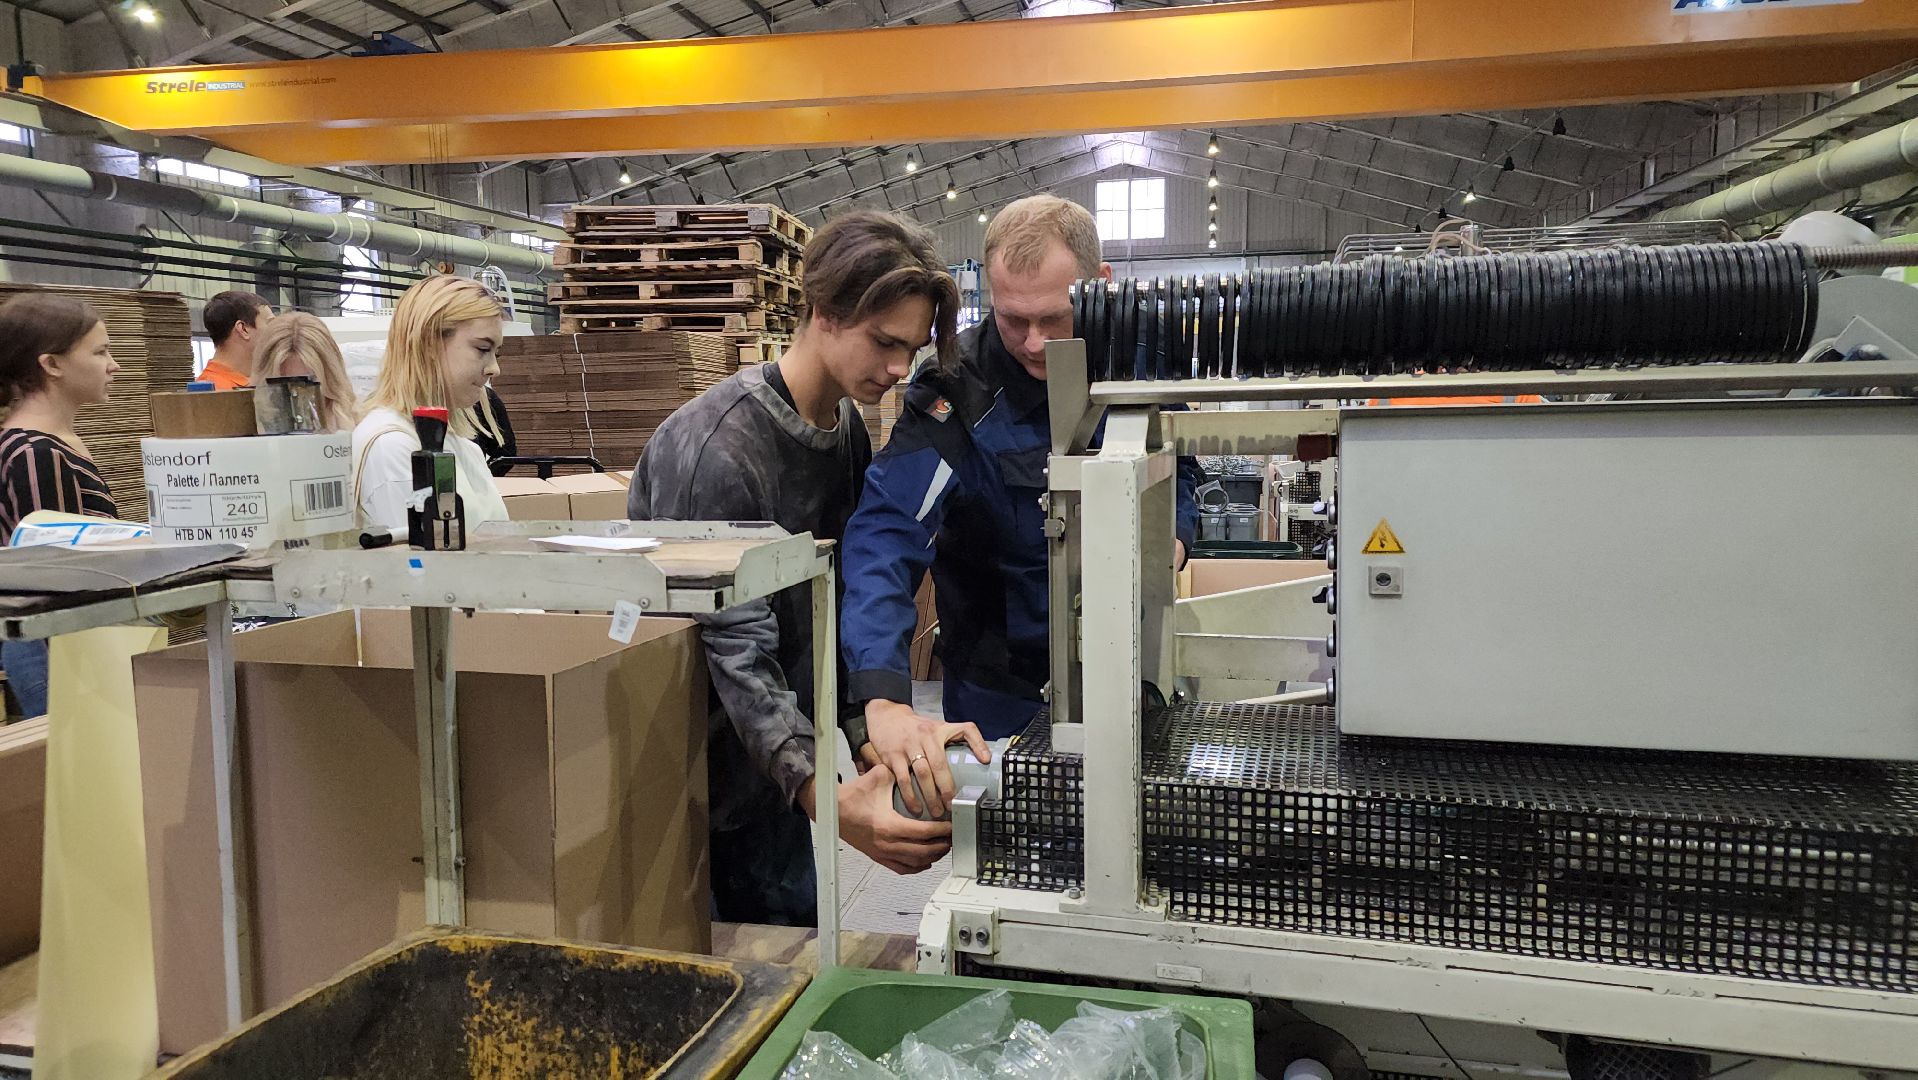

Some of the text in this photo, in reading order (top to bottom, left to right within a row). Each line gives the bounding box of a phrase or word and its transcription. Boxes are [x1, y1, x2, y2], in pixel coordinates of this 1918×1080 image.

[145, 79, 207, 94] Strele
[207, 82, 245, 90] INDUSTRIAL
[323, 444, 352, 459] Oste
[167, 473, 200, 488] Palette
[209, 472, 260, 487] Паллета
[226, 502, 258, 516] 240
[175, 528, 194, 541] HTB
[197, 528, 212, 541] DN
[219, 527, 238, 540] 110
